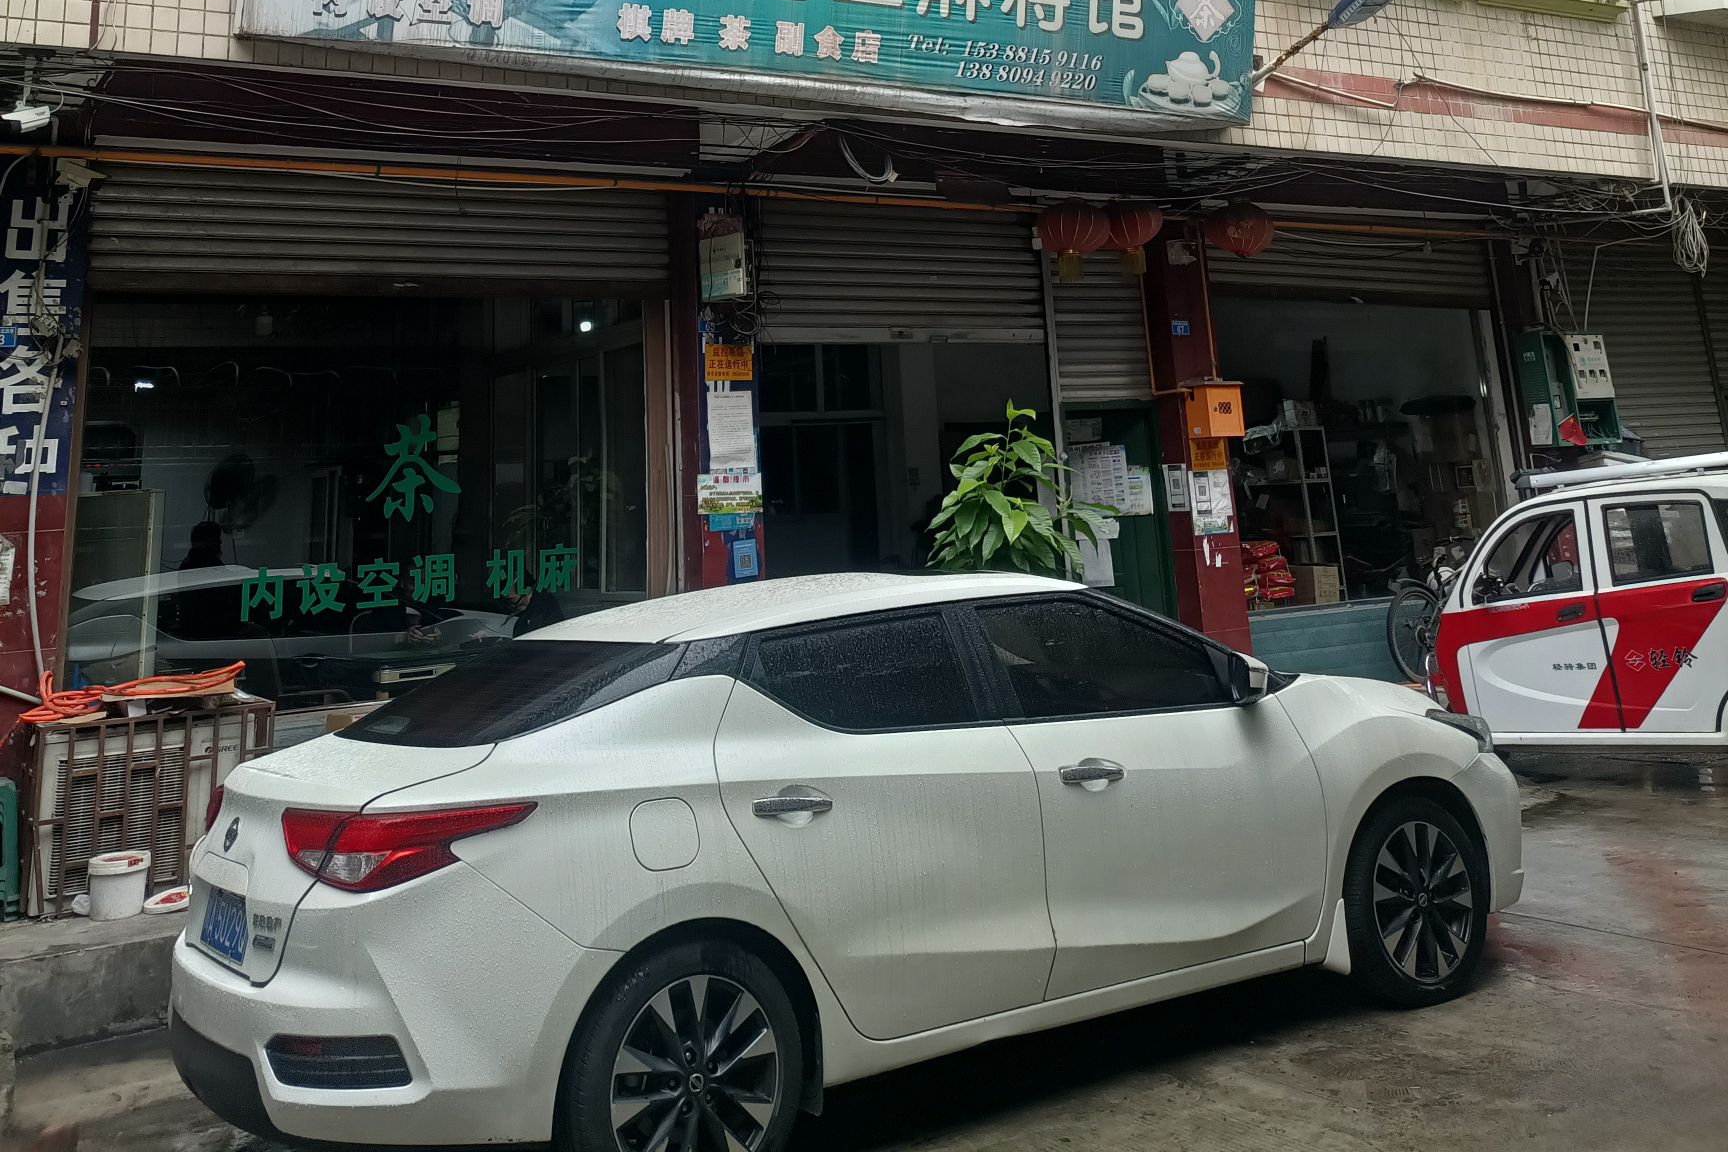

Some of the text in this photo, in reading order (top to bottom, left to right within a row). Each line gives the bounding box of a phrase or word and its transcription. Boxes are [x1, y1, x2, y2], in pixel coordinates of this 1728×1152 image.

[616, 3, 882, 64] 棋牌 茶 副食店
[908, 34, 1104, 71] Tel: 153 8815 9116
[955, 61, 1097, 91] 138 8094 9220
[366, 414, 461, 522] 茶
[240, 543, 577, 622] 内设空调 机麻
